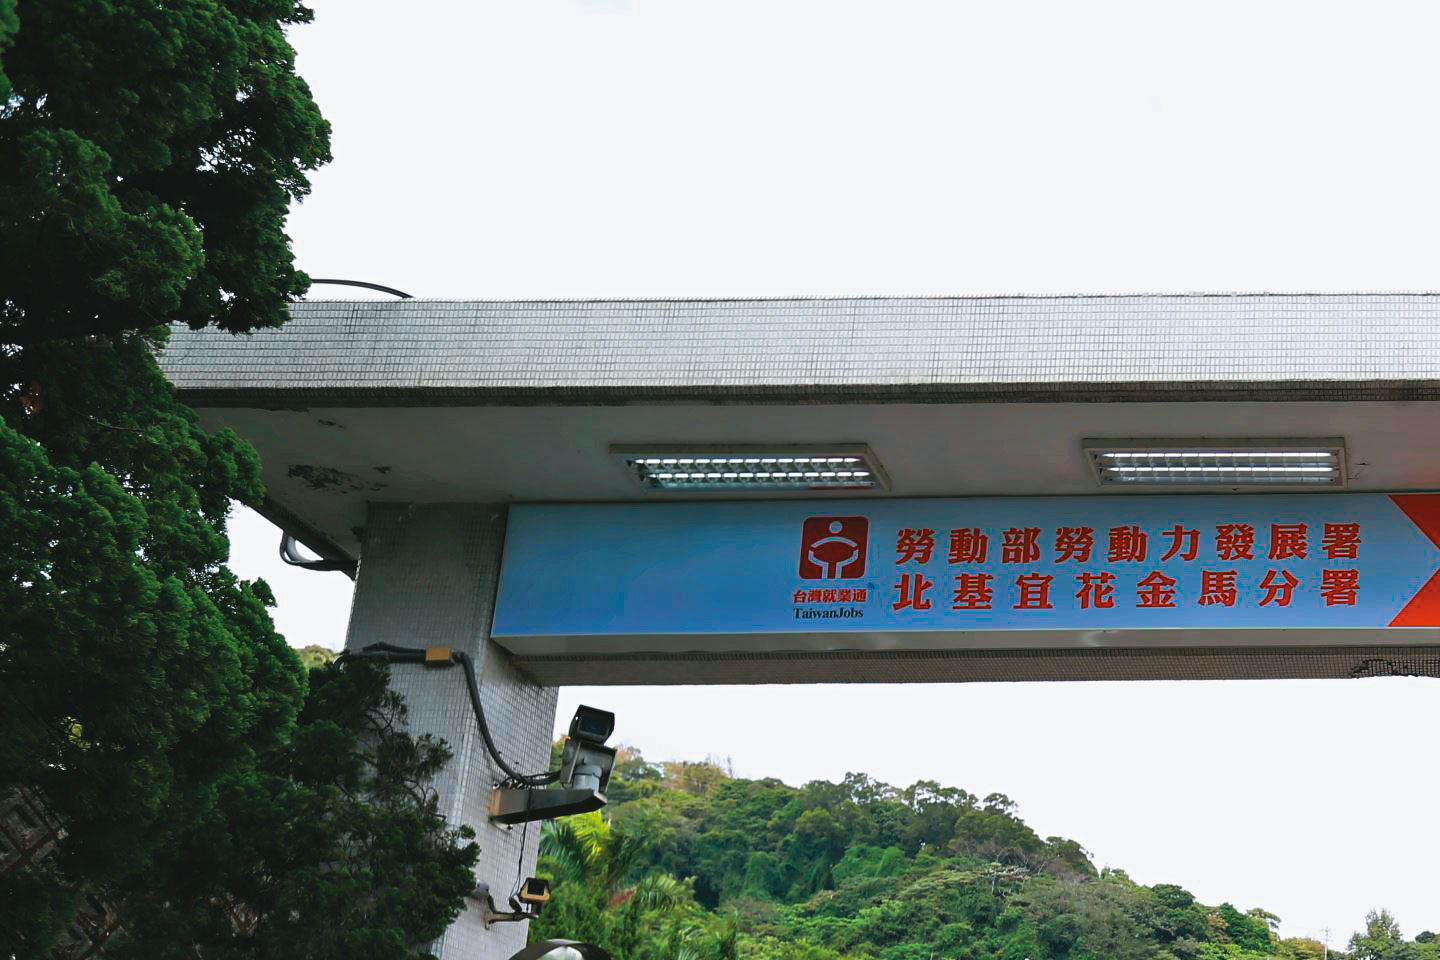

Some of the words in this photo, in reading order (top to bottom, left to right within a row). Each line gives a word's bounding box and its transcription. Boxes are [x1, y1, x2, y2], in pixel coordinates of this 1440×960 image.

[896, 523, 1362, 565] 勞動部勞動力發展署
[792, 588, 867, 604] 台灣就業通
[892, 569, 1361, 611] 北基宜花金馬分署
[792, 606, 864, 620] TaiwanJobs
